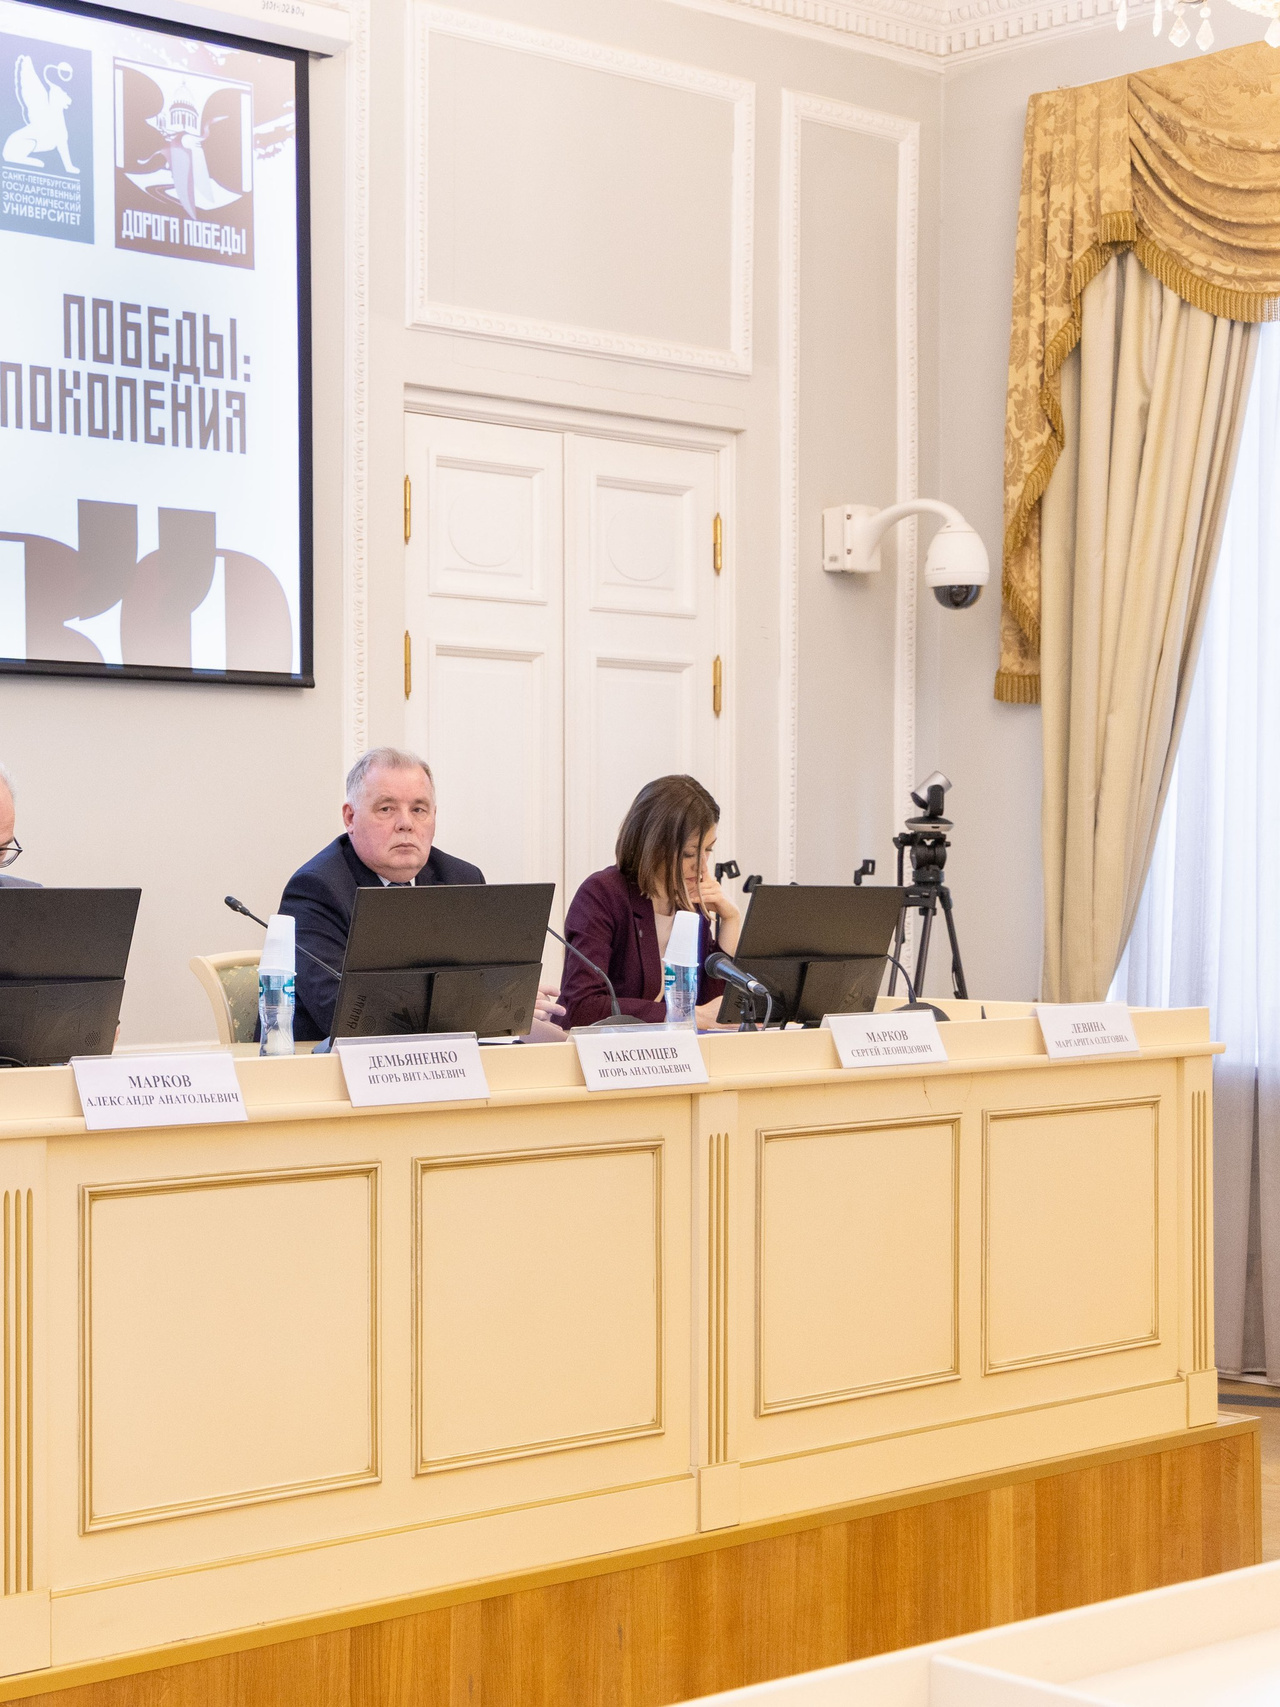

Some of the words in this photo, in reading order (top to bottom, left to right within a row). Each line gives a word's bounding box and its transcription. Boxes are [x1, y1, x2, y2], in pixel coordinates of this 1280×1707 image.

[2, 171, 81, 191] САНКТ-ПЕТЕРБУРГСКИЙ
[2, 181, 81, 202] ГОСУДАРСТВЕННЫЙ
[2, 191, 81, 212] ЭКОНОМИЧЕСКИЙ
[2, 201, 81, 226] УНИВЕРСИТЕТ
[121, 208, 180, 244] ДОРОГА
[183, 219, 247, 256] ПОБЕДЫ
[63, 293, 251, 385] ПОБЕДЫ:
[0, 361, 247, 455] ПОКОЛЕНИЯ
[866, 1029, 909, 1043] МАРКОВ
[1071, 1021, 1107, 1034] ЛЕВИНА
[1055, 1037, 1095, 1049] МАРГАРИТА
[1094, 1034, 1129, 1045] ОЛЕГОВНА
[603, 1047, 678, 1063] МАКСИМЦЕВ
[851, 1045, 881, 1058] СЕРГЕЙ
[882, 1044, 933, 1056] ЛЕОНИДОВИЧ
[368, 1050, 458, 1070] ДЕМЬЯНЕНКО
[368, 1073, 401, 1085] ИГОРЬ
[402, 1068, 466, 1082] ВИТАЛЬЕВИЧ
[598, 1067, 628, 1078] ИГОРЬ
[629, 1063, 692, 1076] АНАТОЛЬЕВИЧ
[128, 1074, 192, 1089] МАРКОВ
[86, 1095, 155, 1107] АЛЕКСАНДР
[158, 1092, 240, 1105] АНАТОЛЬЕВИЧ
